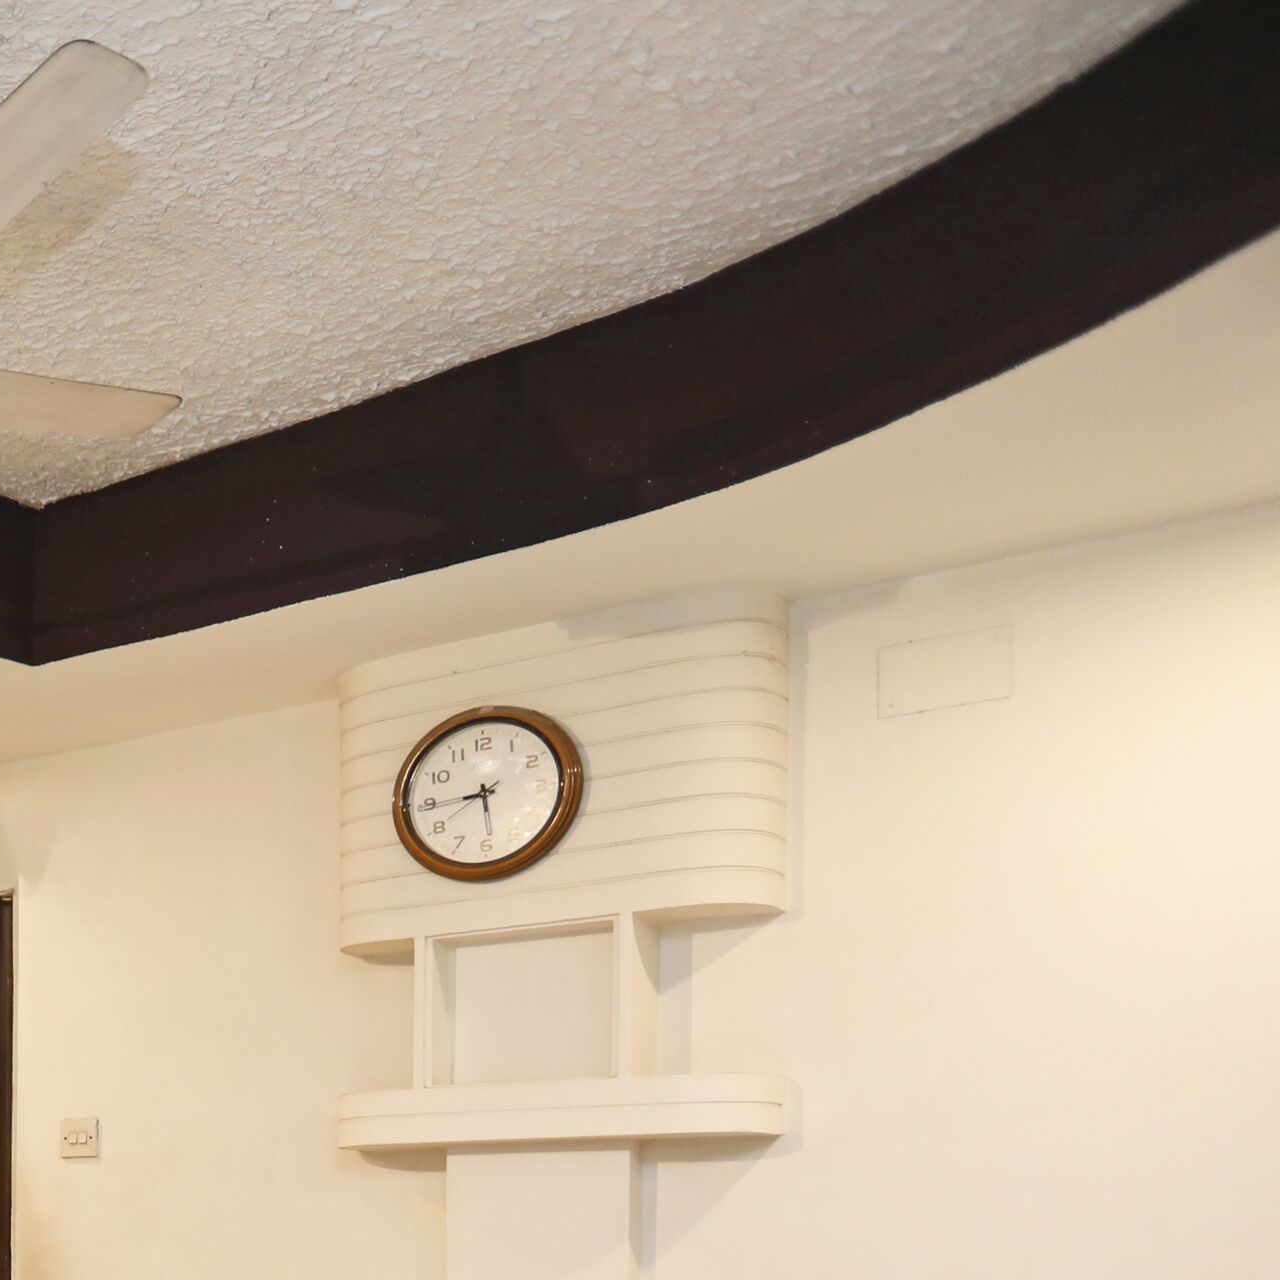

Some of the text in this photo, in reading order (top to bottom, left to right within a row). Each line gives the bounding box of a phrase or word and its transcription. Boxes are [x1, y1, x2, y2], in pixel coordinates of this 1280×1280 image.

[474, 737, 493, 752] 12
[510, 739, 514, 753] 1
[451, 748, 465, 763] 11
[525, 755, 539, 769] 2
[431, 770, 450, 785] 10
[423, 797, 437, 811] 9
[433, 820, 446, 834] 8
[453, 835, 466, 850] 7
[480, 839, 493, 853] 6
